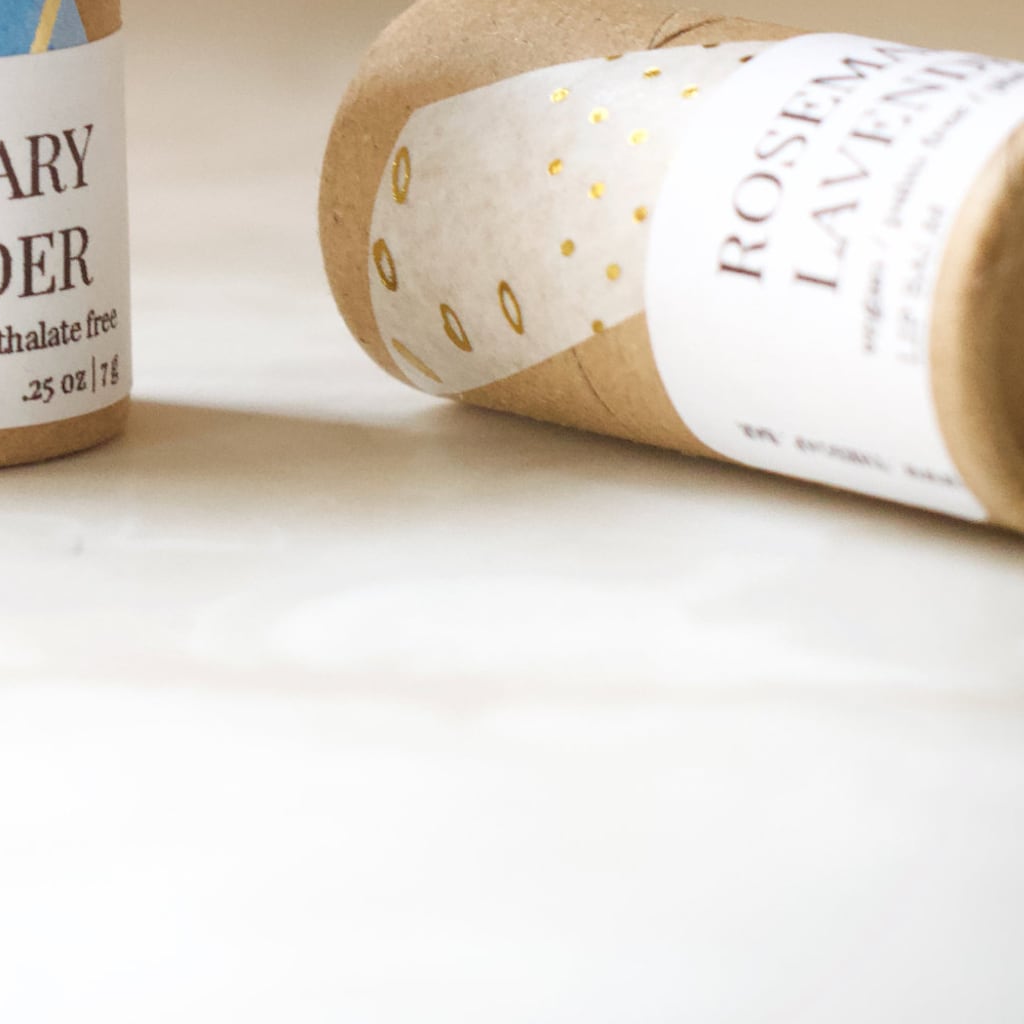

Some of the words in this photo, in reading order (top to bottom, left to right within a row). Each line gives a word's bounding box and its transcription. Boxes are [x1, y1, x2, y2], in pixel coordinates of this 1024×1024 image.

[86, 308, 117, 338] free
[22, 377, 54, 403] .25
[61, 370, 87, 393] oz
